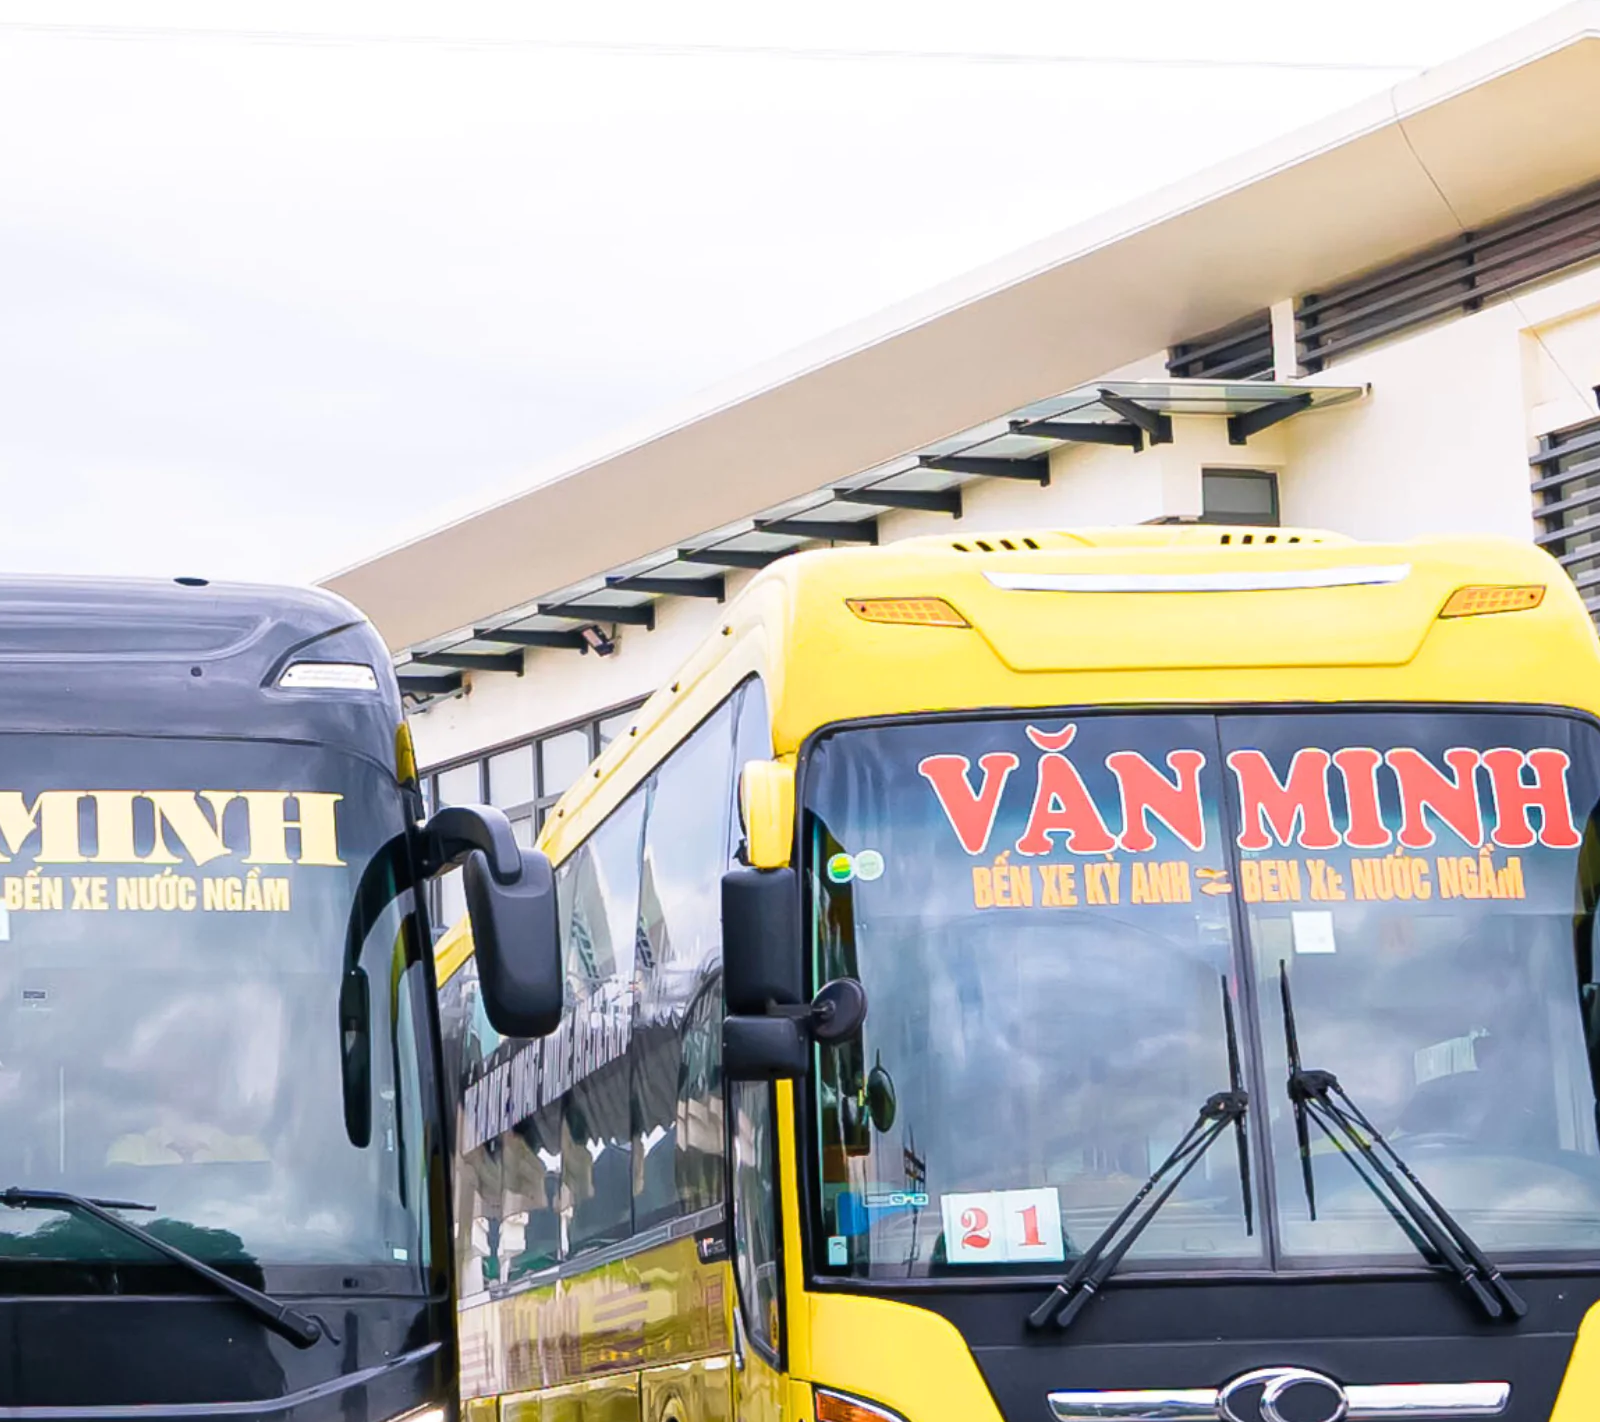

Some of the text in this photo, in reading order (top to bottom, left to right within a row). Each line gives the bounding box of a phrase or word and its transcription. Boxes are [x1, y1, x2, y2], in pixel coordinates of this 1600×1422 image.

[918, 723, 1583, 855] VĂN MINH
[4, 865, 63, 911] BẾN
[71, 877, 109, 911] XE
[116, 866, 197, 911] NƯỚC
[972, 850, 1033, 908] BẾN
[1038, 864, 1078, 907] XE
[1083, 852, 1120, 905] KỲ
[1131, 861, 1191, 904] ANH
[1305, 859, 1346, 901] XE
[1351, 845, 1432, 901] NƯỚC
